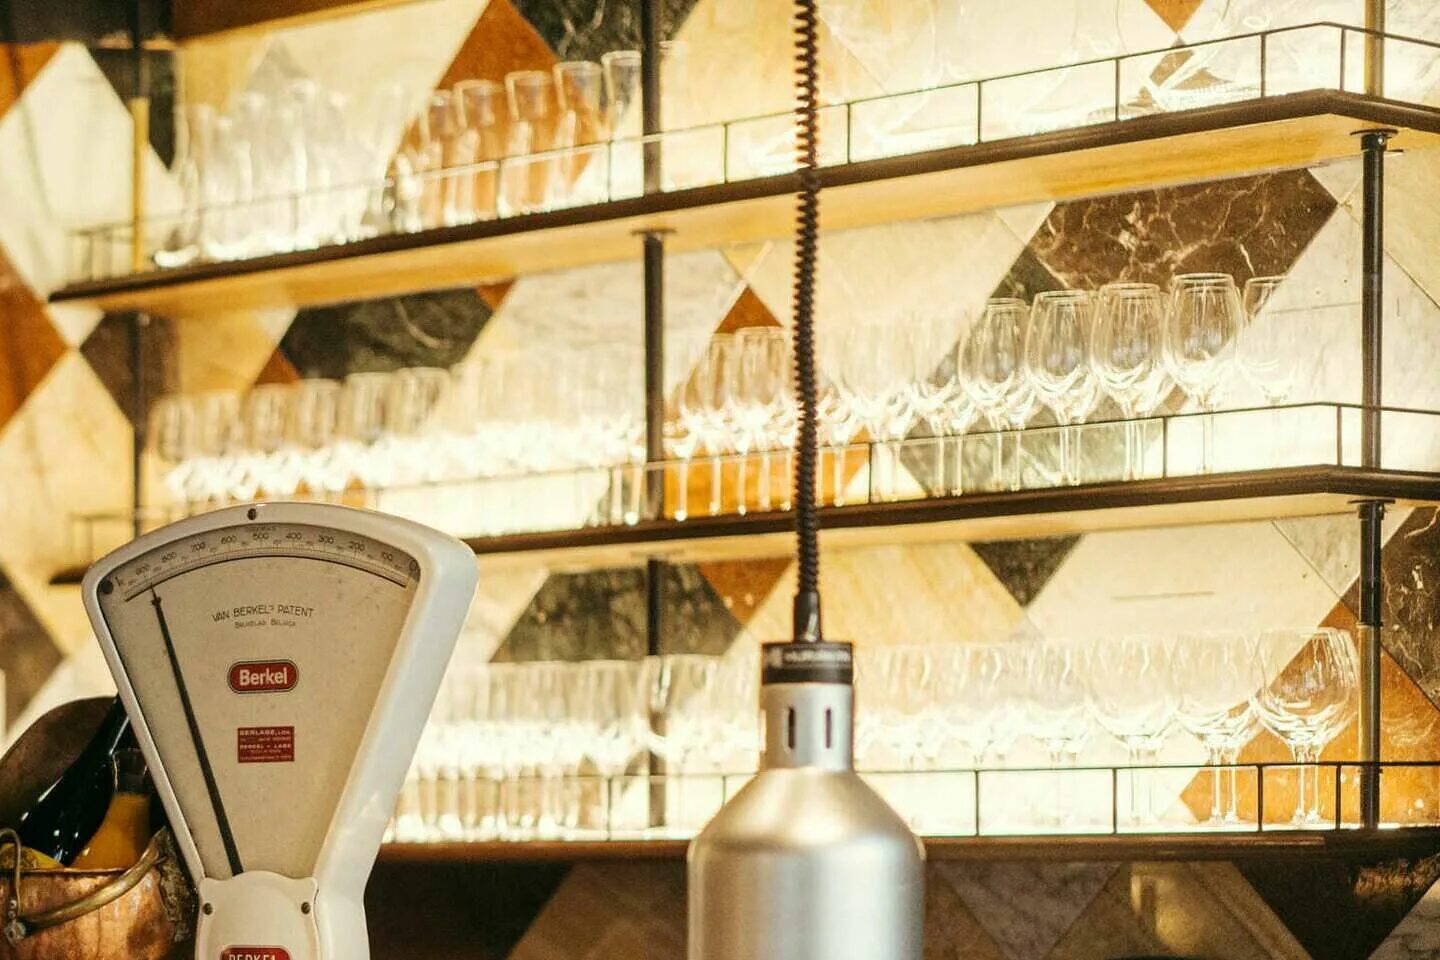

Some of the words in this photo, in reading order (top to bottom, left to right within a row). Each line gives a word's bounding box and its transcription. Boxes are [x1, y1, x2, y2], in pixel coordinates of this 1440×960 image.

[190, 541, 207, 553] 700
[220, 535, 237, 545] 600
[252, 532, 269, 541] 500
[285, 532, 302, 541] 400
[318, 534, 335, 544] 300
[348, 541, 366, 552] 200
[211, 610, 231, 622] VAN
[278, 604, 315, 617] PATENT
[239, 667, 288, 686] Berkel
